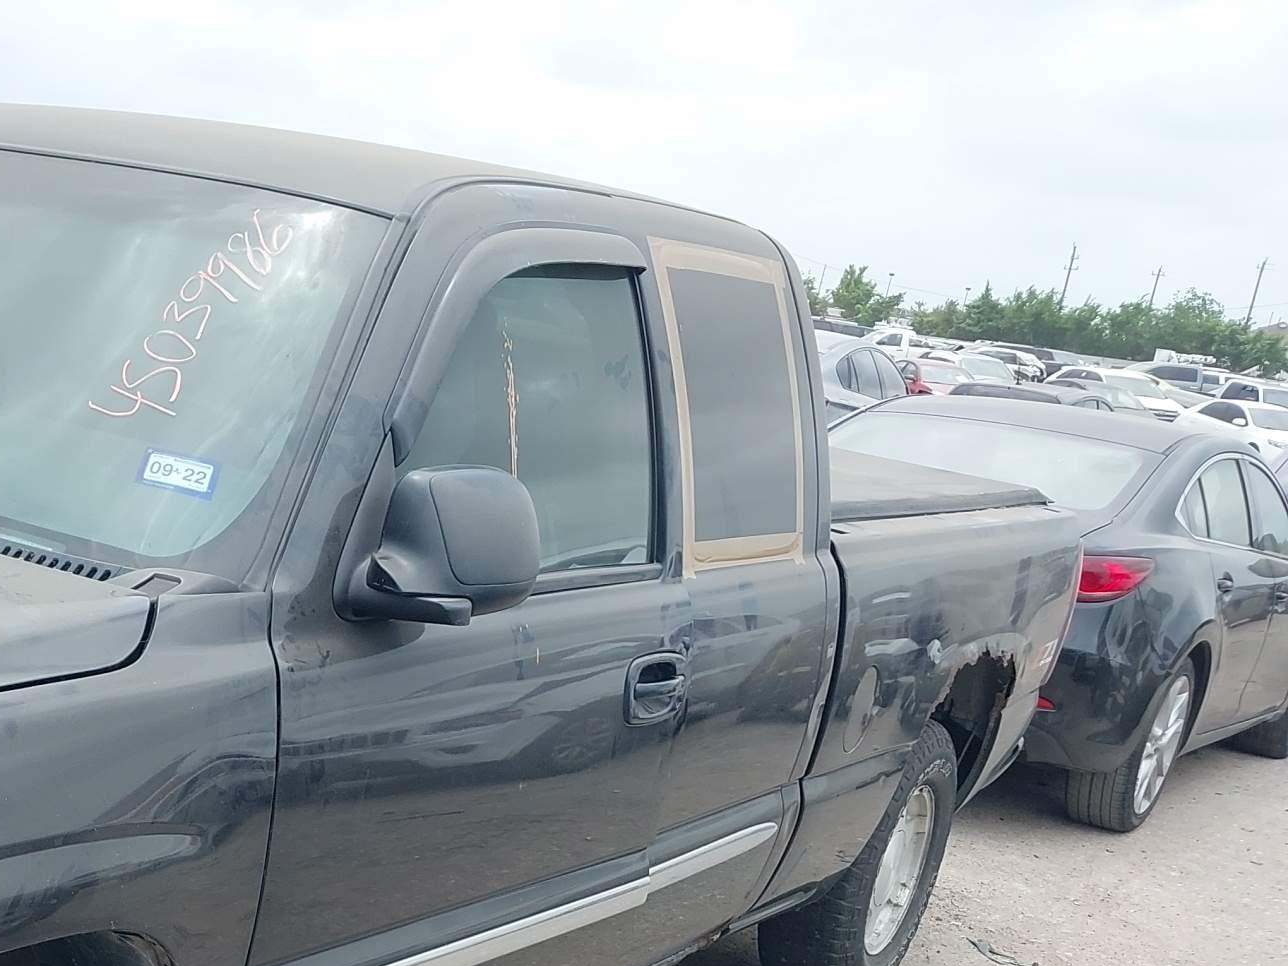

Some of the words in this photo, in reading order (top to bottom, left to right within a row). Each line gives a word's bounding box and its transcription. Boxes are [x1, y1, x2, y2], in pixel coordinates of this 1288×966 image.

[89, 208, 294, 417] 45039986
[149, 460, 174, 477] 09
[182, 467, 208, 486] 22
